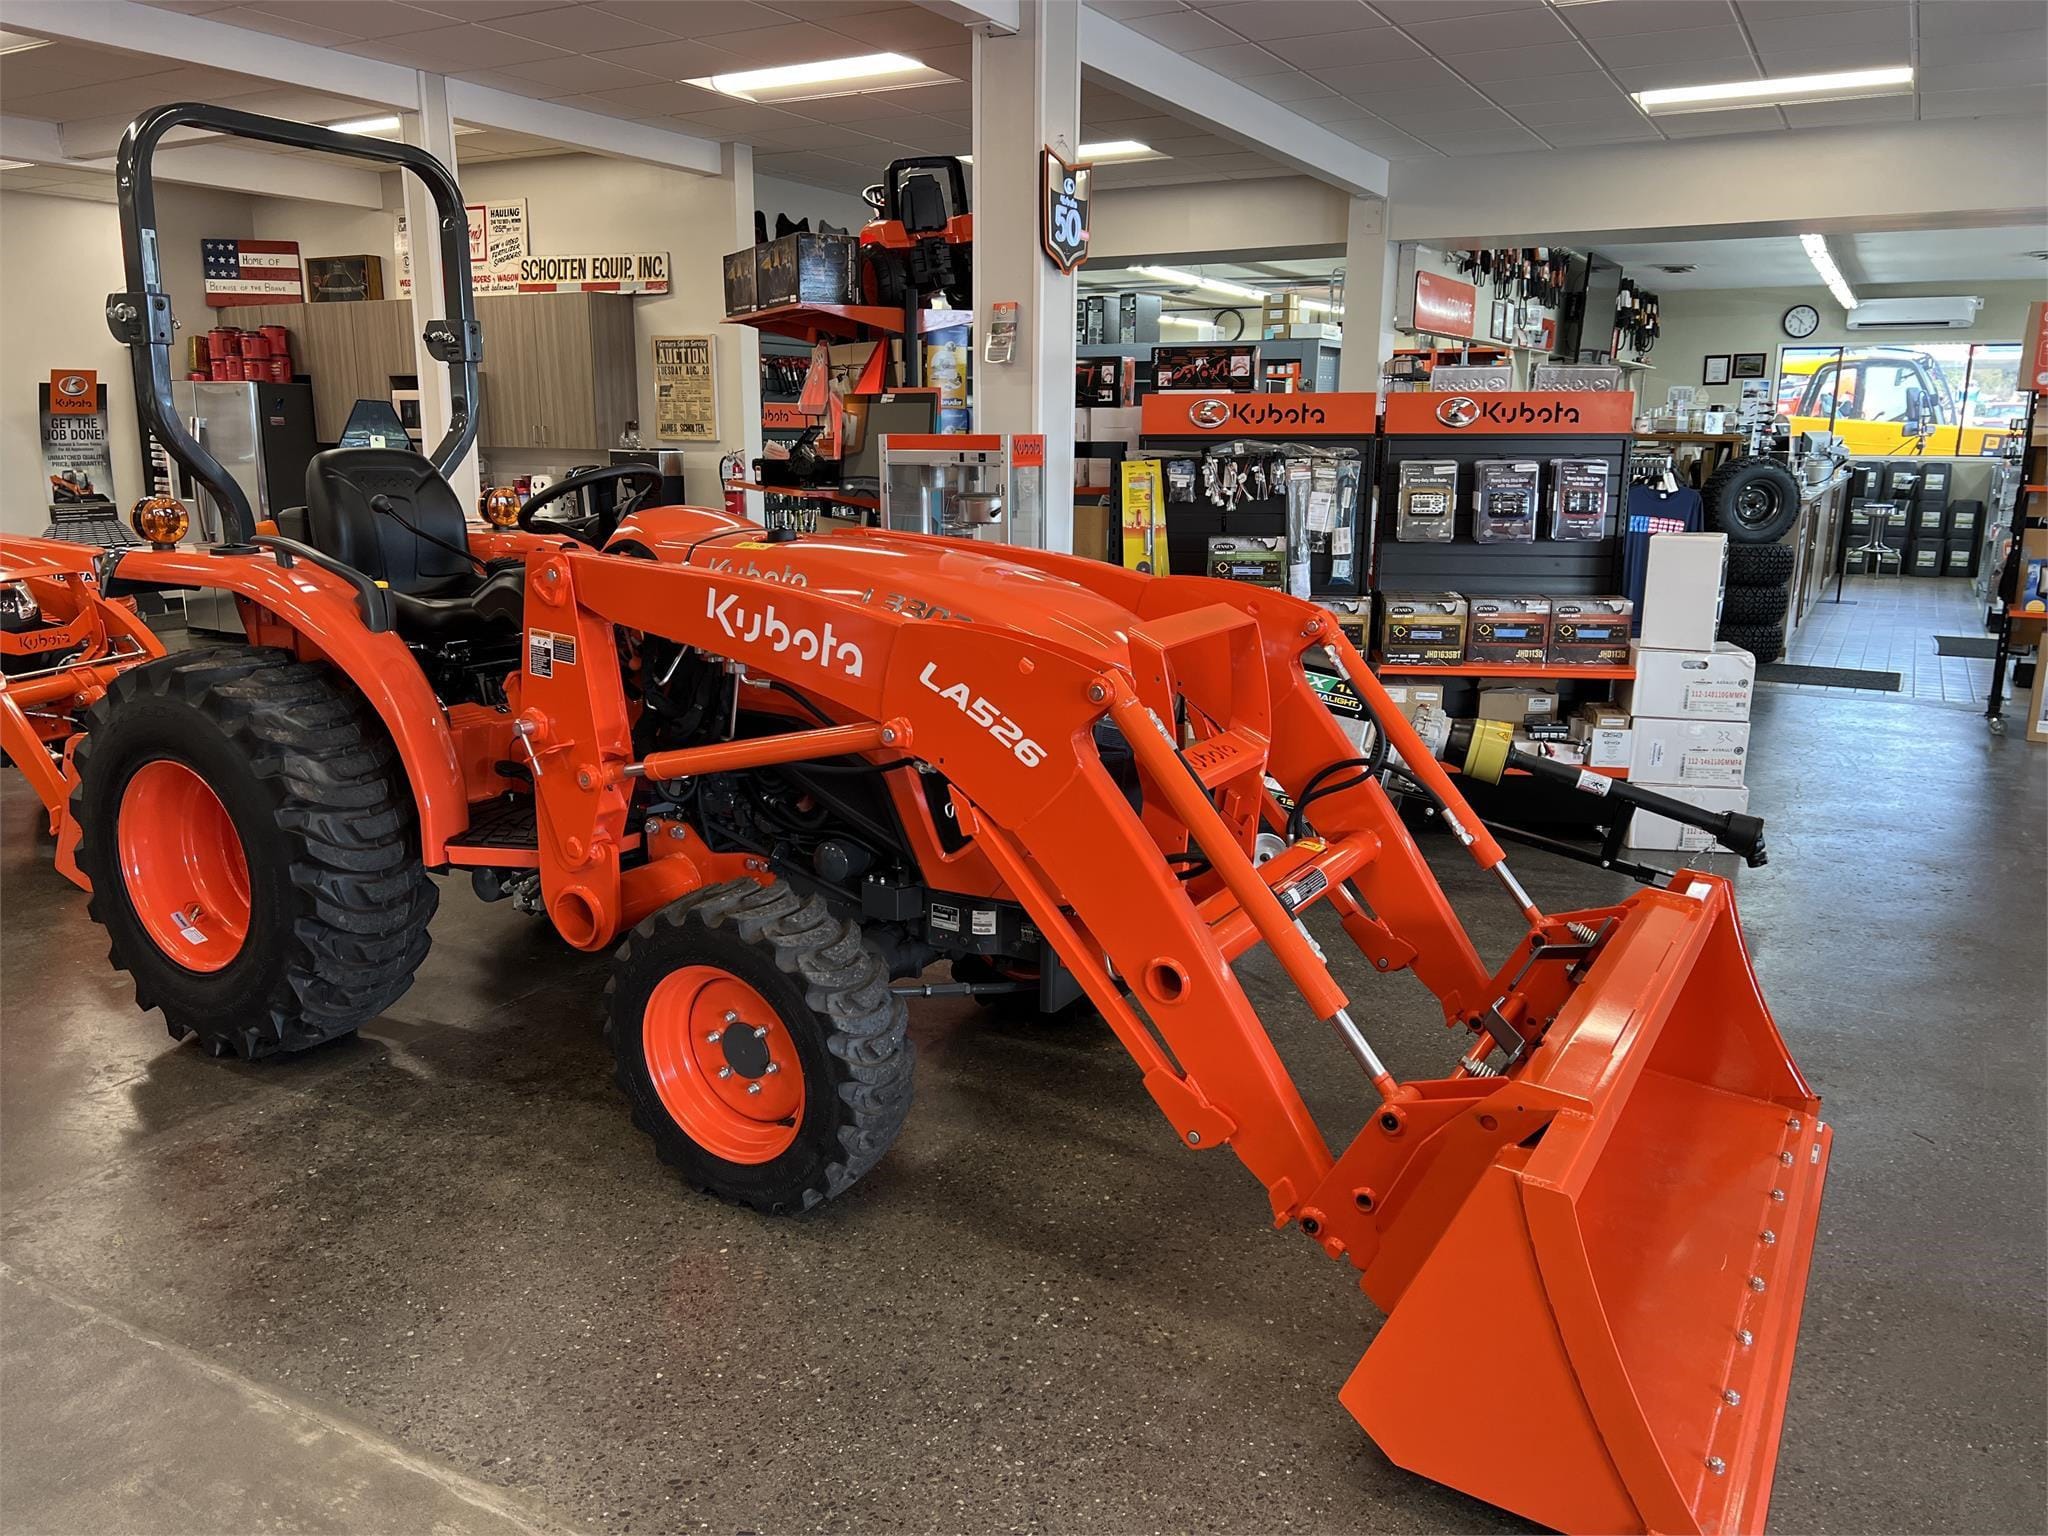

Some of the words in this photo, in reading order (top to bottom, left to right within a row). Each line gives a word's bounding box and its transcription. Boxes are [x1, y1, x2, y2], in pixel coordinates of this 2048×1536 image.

[491, 208, 520, 217] HAULING
[1055, 204, 1081, 246] 50
[491, 243, 521, 259] FERTILIZER
[242, 255, 263, 265] HOME
[521, 258, 587, 281] SCHOLTEN
[638, 256, 665, 279] INC.
[472, 273, 492, 283] ADERS
[210, 281, 237, 291] BECAUSE
[265, 282, 286, 291] BRAVE
[658, 348, 708, 364] AUCTION
[658, 366, 682, 376] TUESDAY
[686, 365, 700, 375] AUG.
[703, 365, 710, 375] 20
[56, 398, 92, 408] Kubota
[764, 410, 789, 422] ubota
[1232, 403, 1325, 425] Kubota
[1482, 401, 1580, 424] Kubota
[52, 418, 72, 429] GET
[77, 418, 97, 429] THE
[660, 423, 678, 433] JAMES
[680, 423, 705, 433] SCHOLTEN
[45, 430, 67, 441] JOB
[71, 430, 105, 441] DONE!
[1016, 440, 1042, 455] Kubota
[706, 587, 864, 678] Kubota
[19, 632, 71, 650] Kubota
[1515, 650, 1543, 658] JHD1130
[1598, 650, 1626, 658] JHD1130
[919, 661, 1049, 769] LA526
